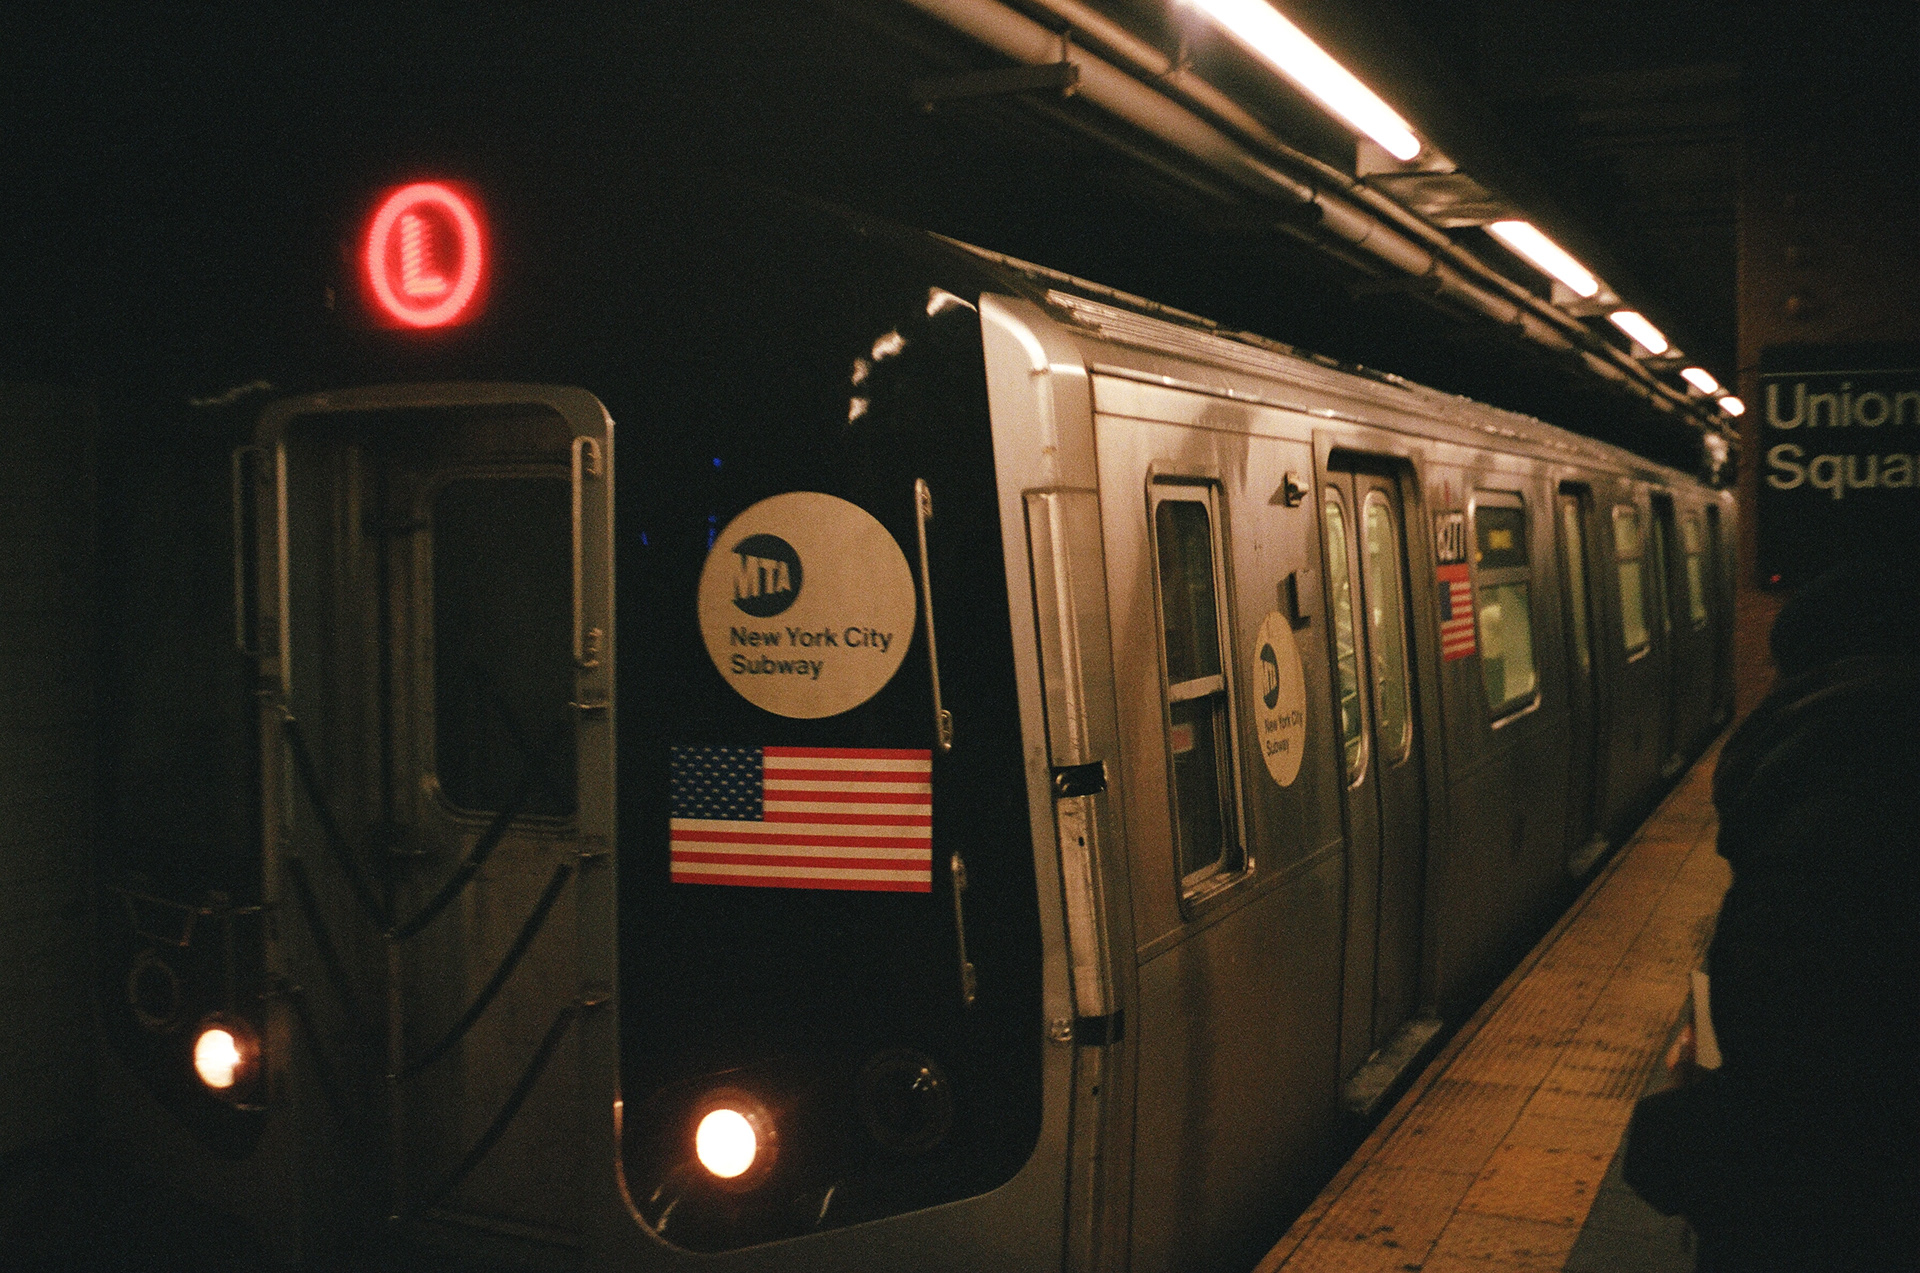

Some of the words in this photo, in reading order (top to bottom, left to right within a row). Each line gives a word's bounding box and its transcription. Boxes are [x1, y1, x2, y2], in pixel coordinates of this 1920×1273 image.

[401, 214, 448, 296] L
[1766, 381, 1920, 430] Union
[1766, 443, 1920, 500] Squa
[733, 552, 792, 600] MTA
[730, 626, 781, 647] New
[785, 626, 839, 648] York
[843, 626, 892, 653] City
[730, 653, 824, 680] Subway
